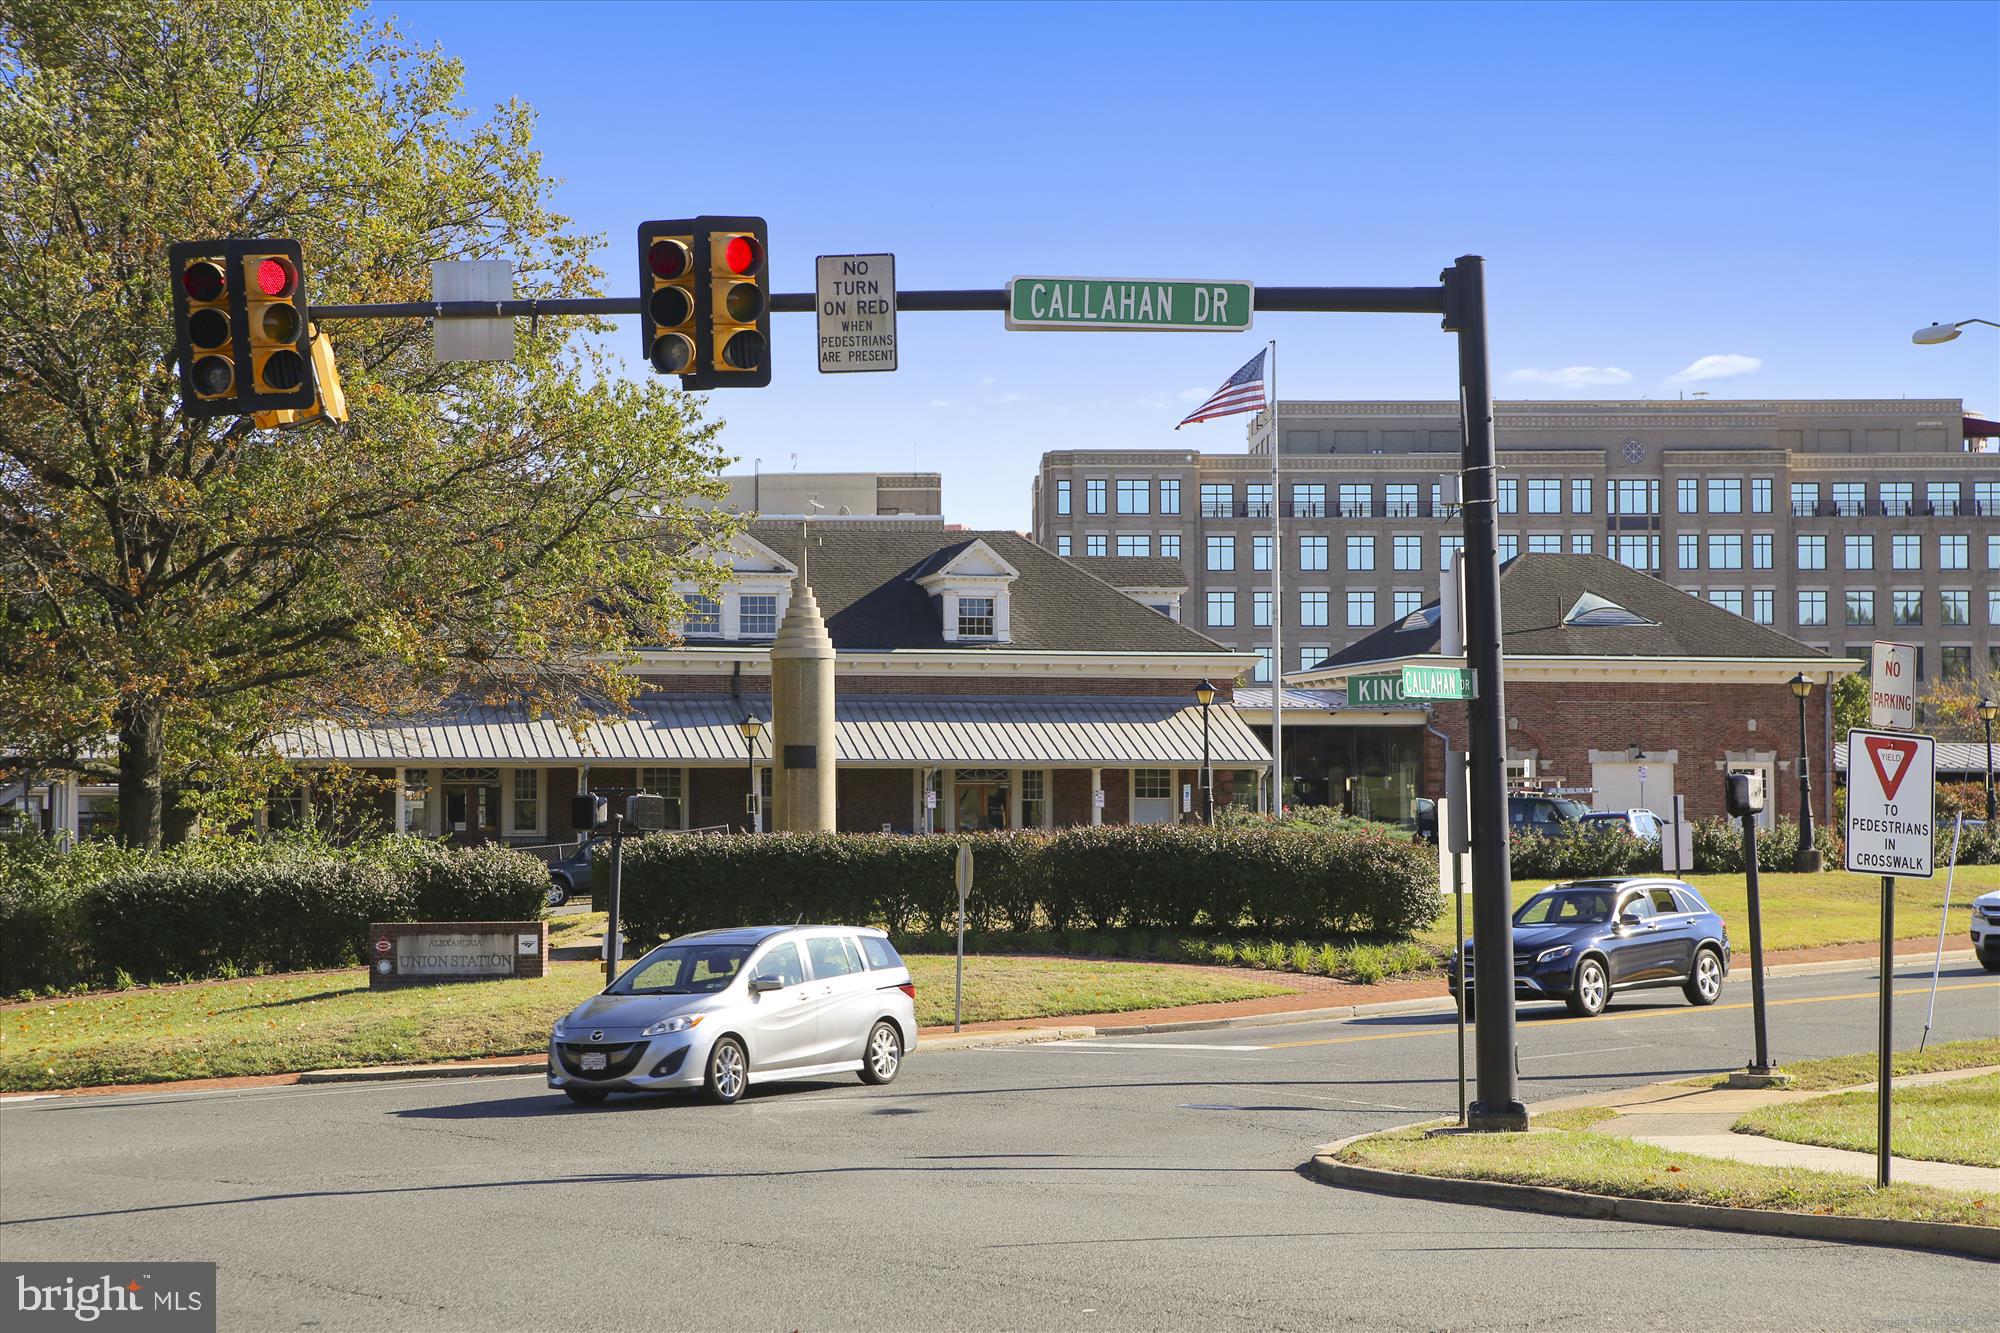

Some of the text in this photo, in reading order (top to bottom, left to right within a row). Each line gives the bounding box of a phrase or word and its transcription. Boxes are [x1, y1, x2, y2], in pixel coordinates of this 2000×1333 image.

[843, 261, 869, 276] NO
[833, 280, 879, 296] TURN
[823, 300, 889, 316] ON RED
[1031, 283, 1228, 323] CALLAHAN DR
[841, 320, 873, 332] WHEN
[821, 334, 894, 348] PEDESTRIANS
[822, 350, 894, 363] ARE PRESENT
[1885, 660, 1901, 678] NO
[1405, 671, 1470, 695] CALLAHAN DR
[1873, 691, 1912, 712] PARKING
[1881, 752, 1901, 761] YIELD
[1884, 803, 1899, 817] TO
[1852, 818, 1929, 836] PEDESTRIANS
[1884, 838, 1896, 851] IN
[1856, 853, 1924, 871] CROSSWALK
[428, 939, 483, 948] ALEXANDRIA
[400, 953, 513, 969] UNION STATION
